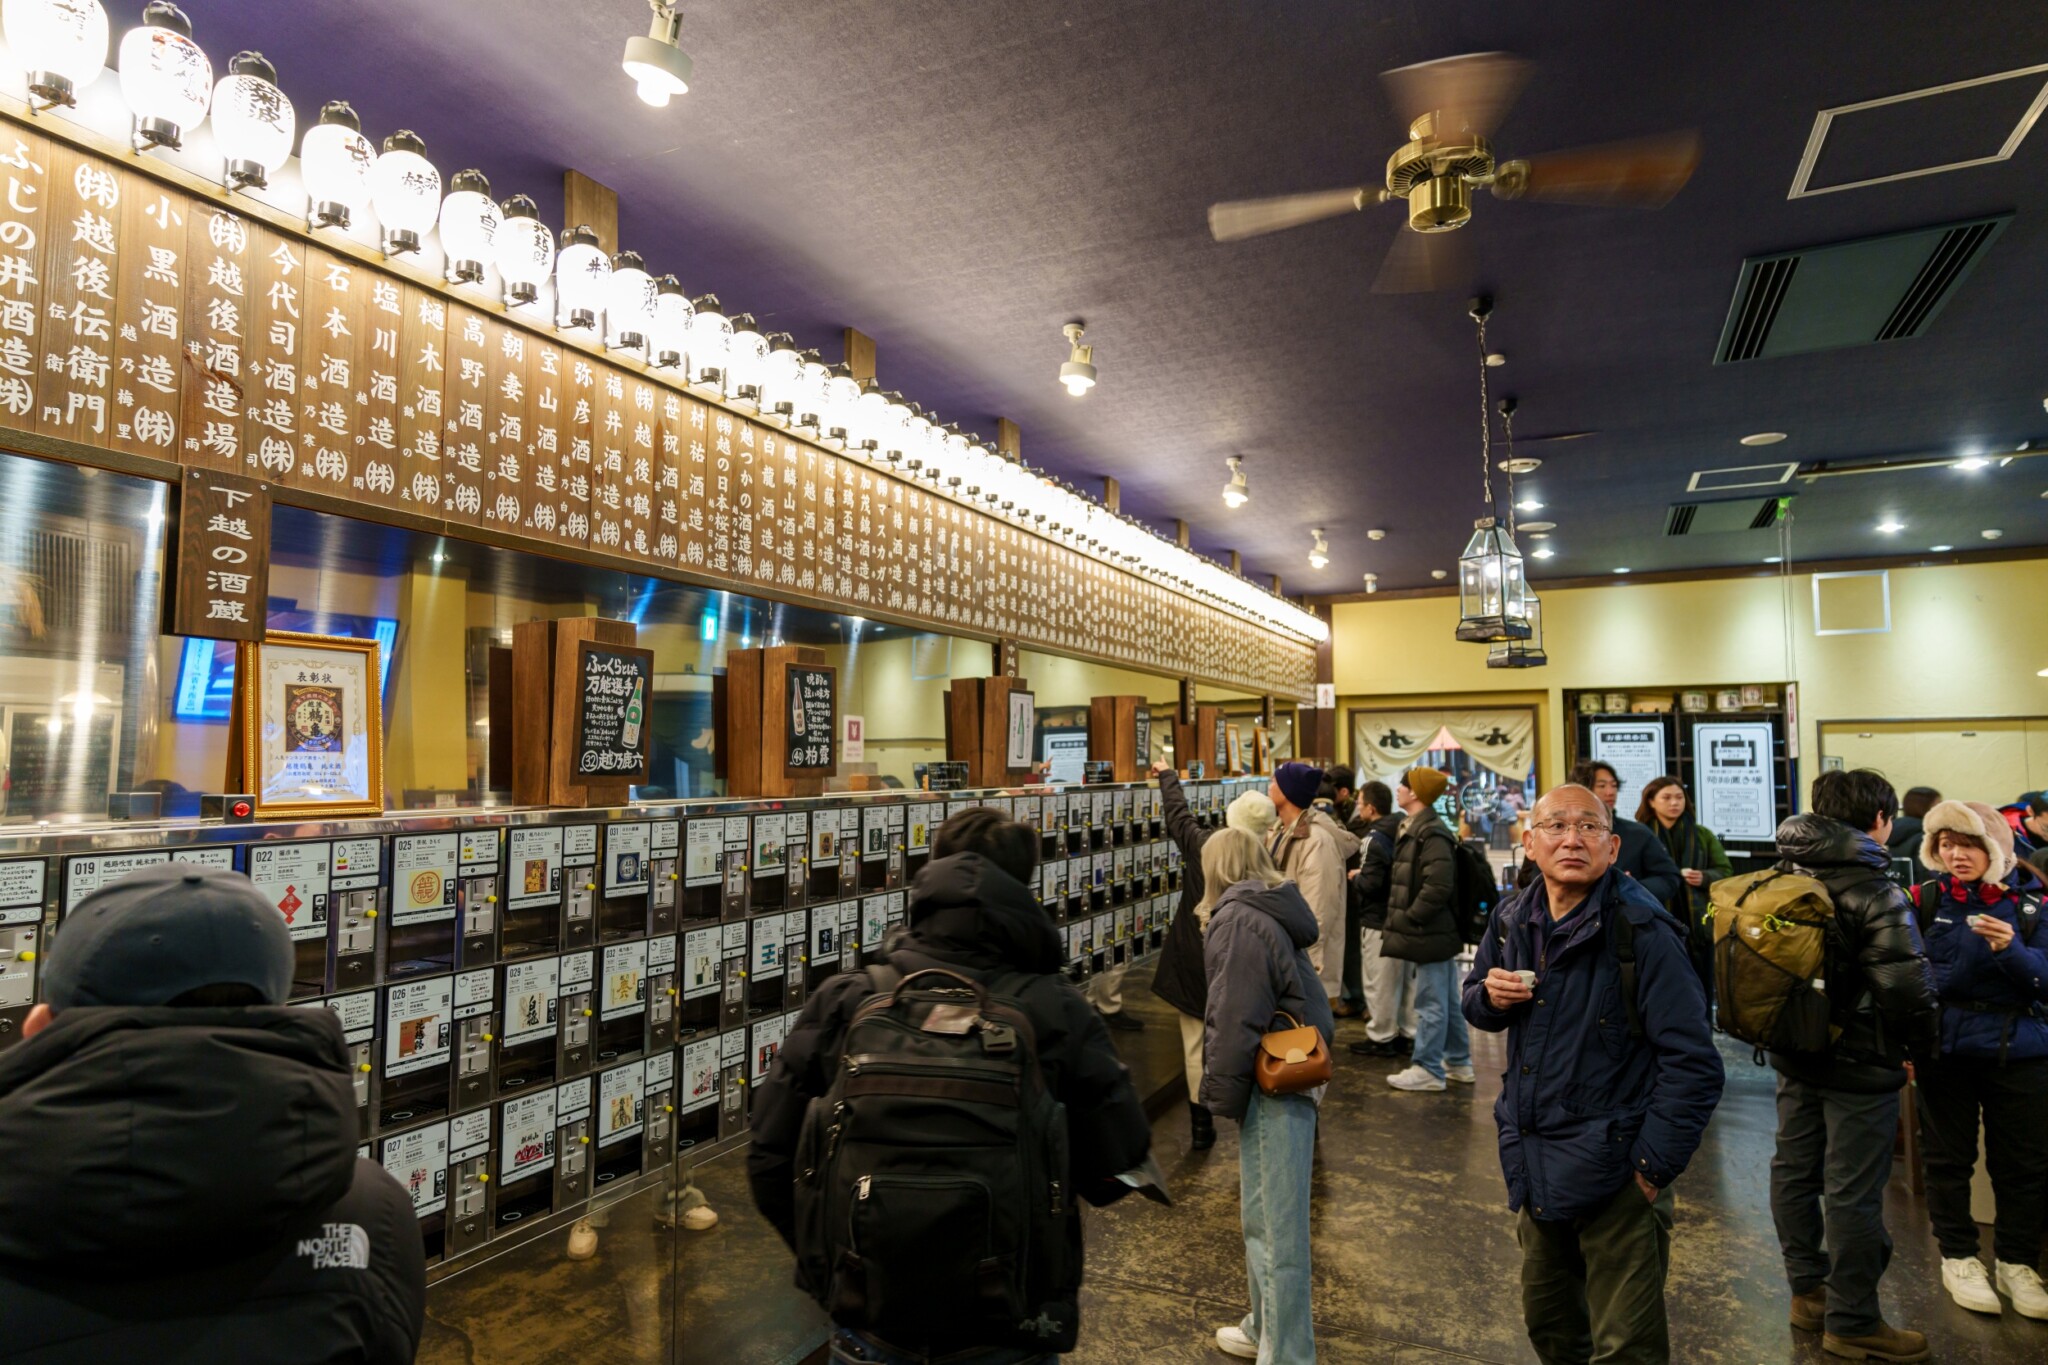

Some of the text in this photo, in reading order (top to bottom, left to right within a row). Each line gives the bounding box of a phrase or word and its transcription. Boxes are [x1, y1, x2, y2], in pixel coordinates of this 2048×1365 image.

[43, 302, 69, 426] 伝衛門
[117, 324, 138, 441] 越乃梅里
[185, 340, 202, 454] 甘雨
[247, 360, 263, 468] 今代司
[302, 374, 319, 477] 越乃寒梅
[353, 391, 369, 490] 越の関
[401, 405, 416, 501] 鶴の友
[206, 486, 253, 623] 下越の酒蔵
[586, 654, 639, 675] ふっくらとした
[296, 671, 332, 683] 表彰状
[585, 675, 634, 698] 万能選手
[583, 749, 643, 770] 32 越乃鹿六
[610, 828, 619, 837] 031
[688, 822, 698, 831] 034
[513, 832, 525, 842] 028
[398, 840, 412, 851] 025
[103, 859, 133, 869] 越路吹雪
[255, 850, 273, 863] 022
[75, 861, 95, 876] 019
[605, 946, 616, 958] 032
[509, 967, 521, 978] 029
[392, 989, 406, 1000] 026
[603, 1073, 613, 1084] 033
[506, 1103, 518, 1115] 030
[387, 1140, 401, 1152] 027
[322, 1223, 351, 1238] THE
[297, 1238, 351, 1257] NORTH
[313, 1252, 352, 1269] FACE
